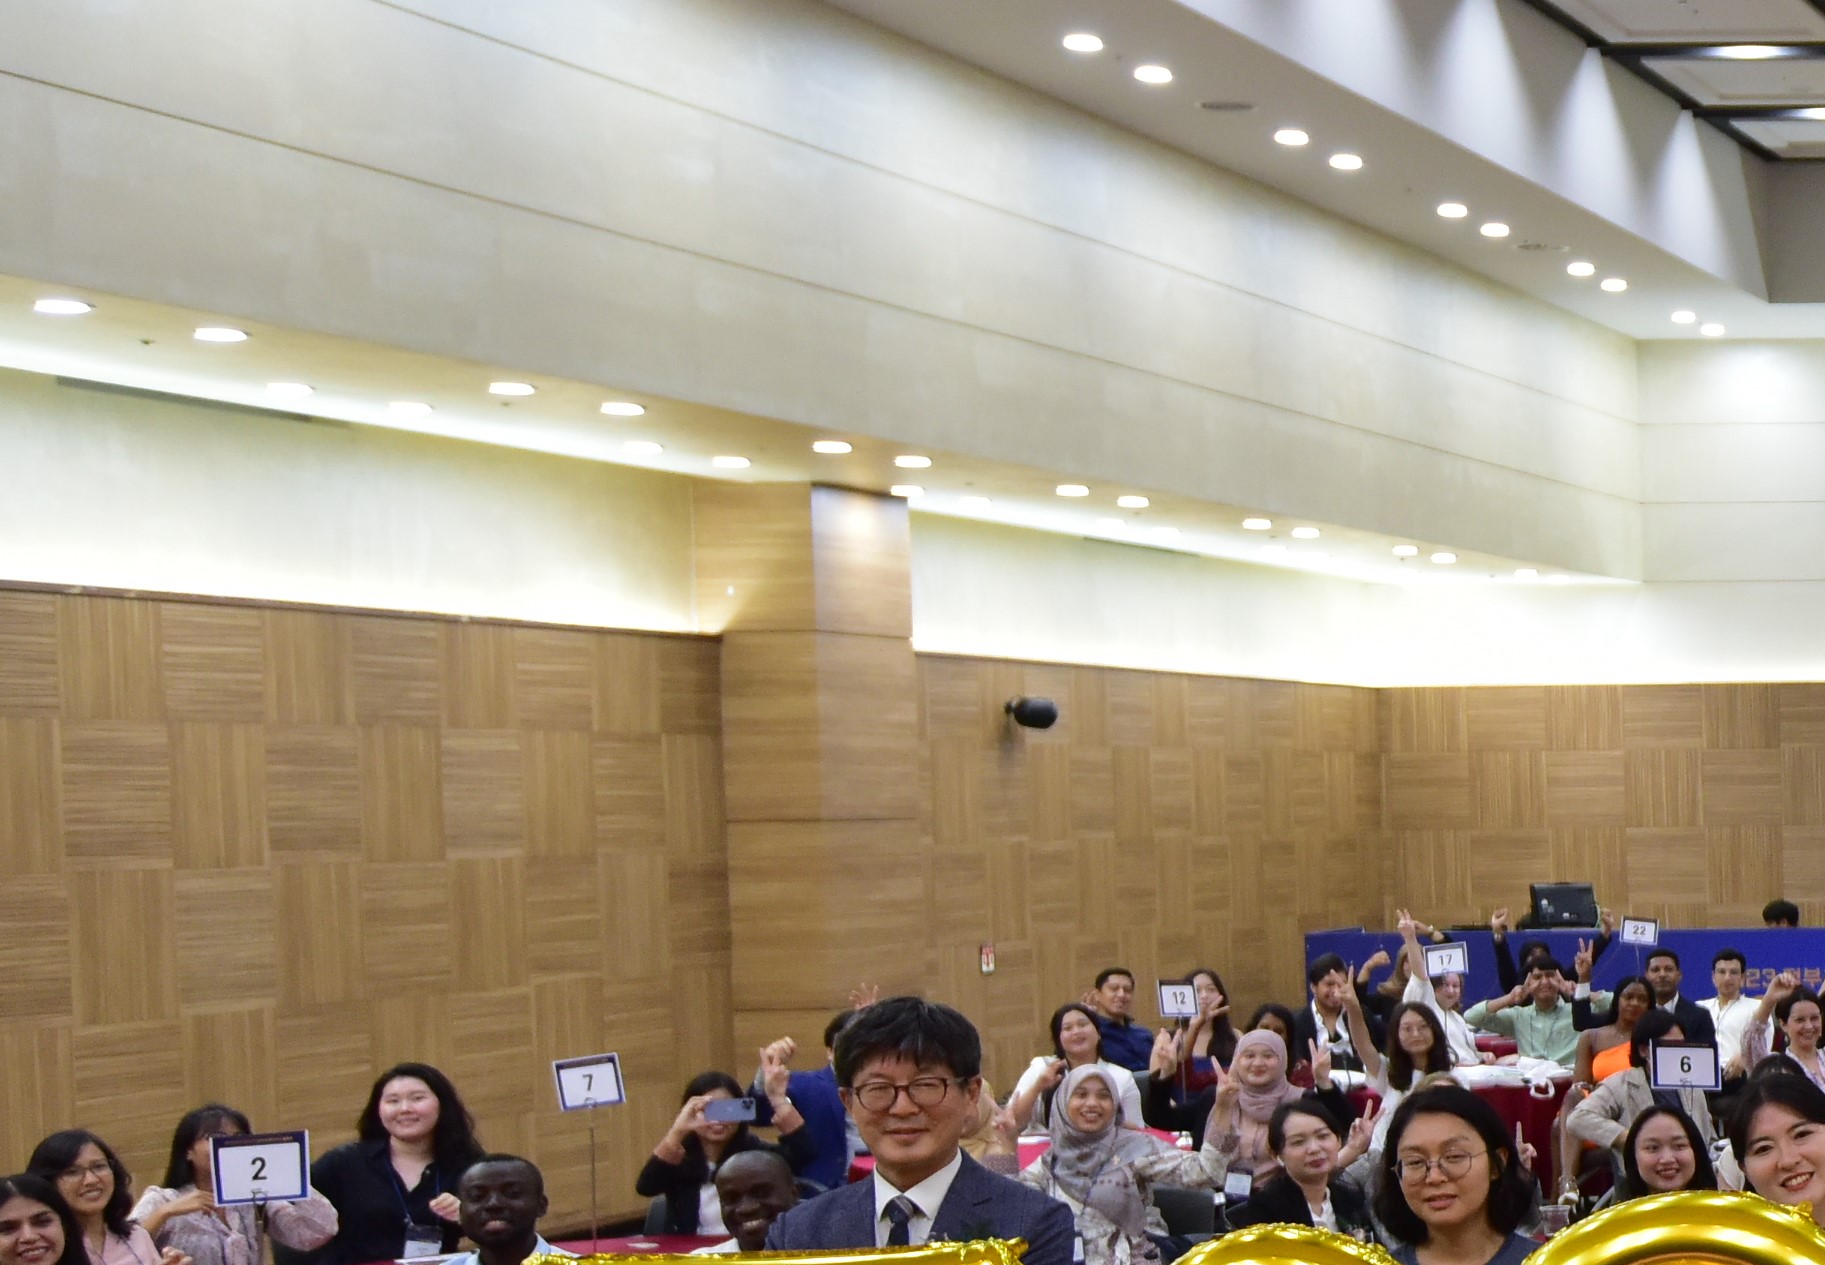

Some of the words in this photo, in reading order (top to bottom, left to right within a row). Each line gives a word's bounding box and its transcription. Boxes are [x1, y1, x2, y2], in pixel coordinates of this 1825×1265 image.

[1633, 925, 1646, 935] 22
[1439, 955, 1452, 965] 17
[1172, 991, 1186, 1004] 12
[1680, 1055, 1691, 1073] 6
[583, 1073, 594, 1091] 7
[251, 1157, 267, 1181] 2
